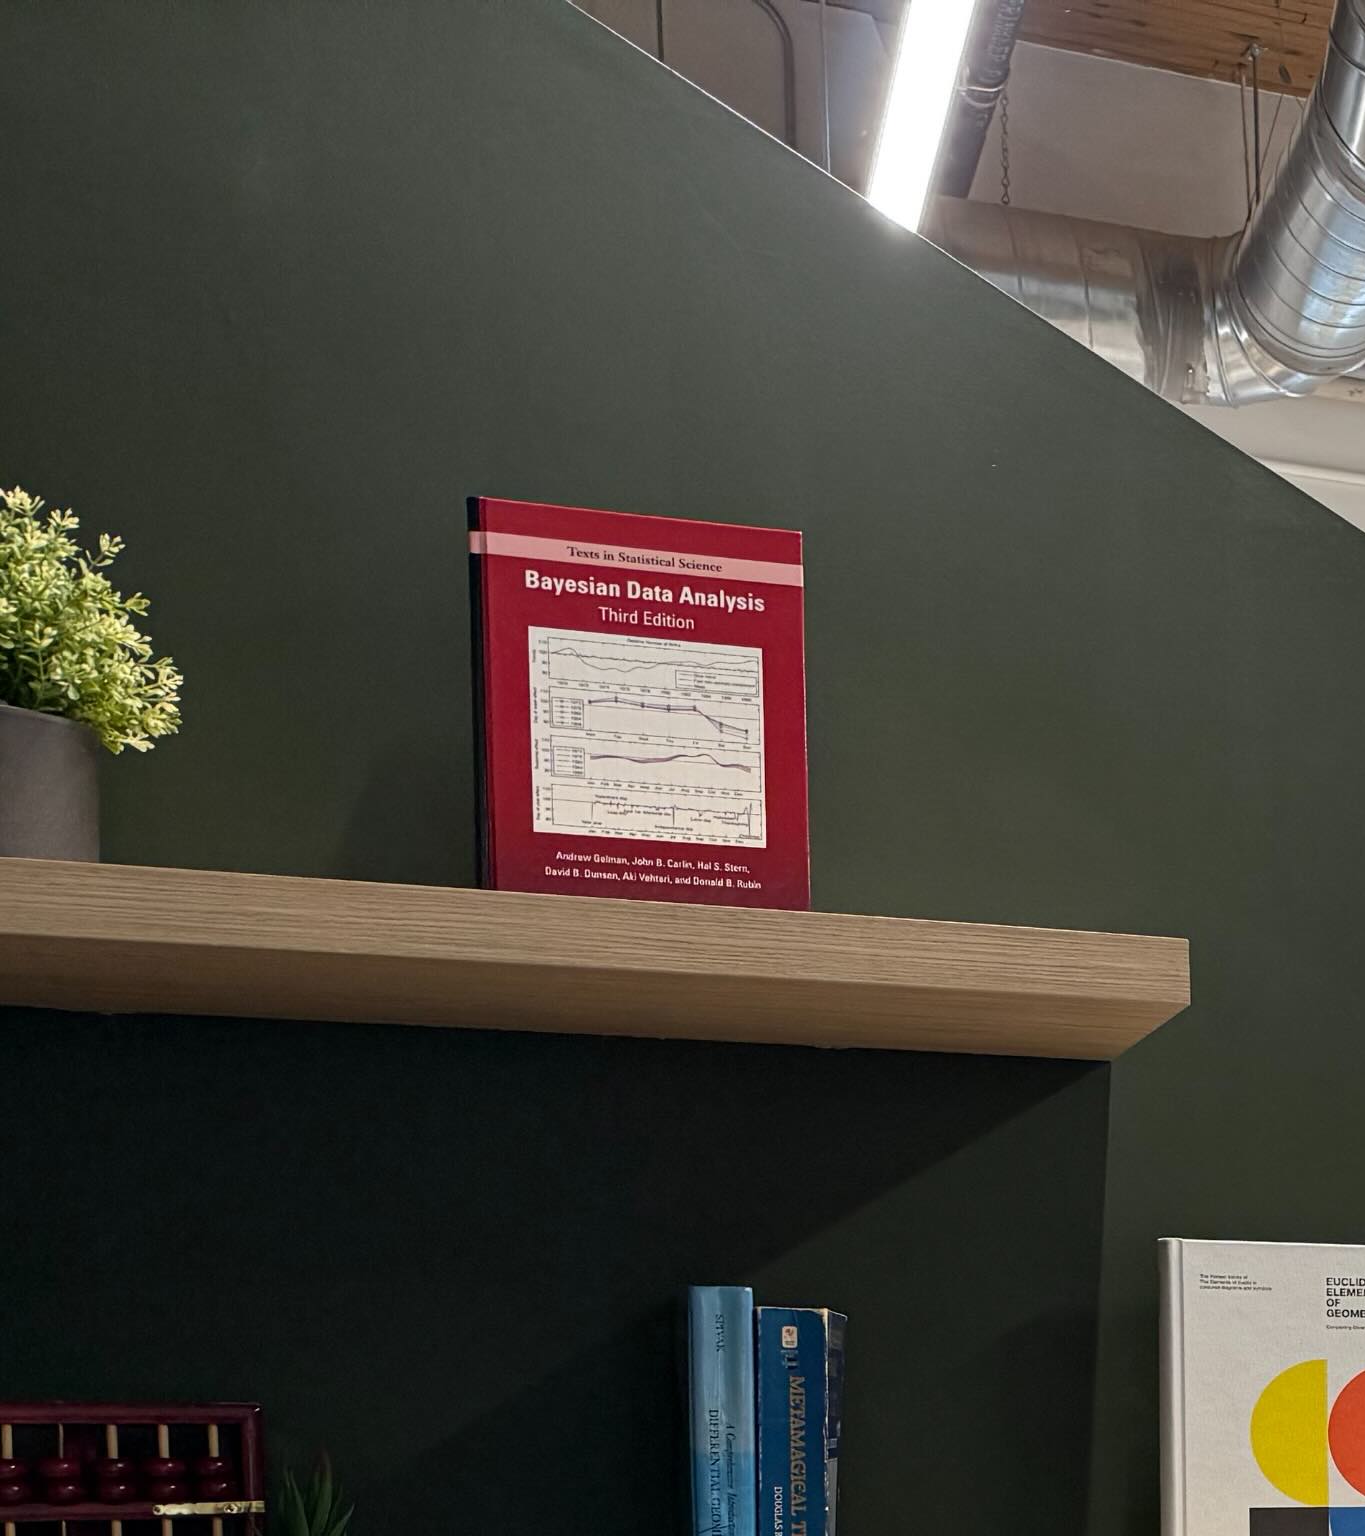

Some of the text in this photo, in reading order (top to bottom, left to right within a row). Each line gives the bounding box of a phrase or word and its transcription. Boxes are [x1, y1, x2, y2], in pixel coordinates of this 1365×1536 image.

[567, 546, 722, 572] Texts in Statistical Science
[525, 570, 766, 612] Bayesian Data Analysis
[598, 606, 695, 630] Third Edition
[545, 867, 762, 889] David B. Dunson, Aki Vehtari, and Donald B. Rubin
[556, 851, 751, 874] Andrew Gelman, John B. Carlin, Hal S. Stern,
[1326, 1298, 1341, 1307] OF
[715, 1314, 725, 1352] SPIVAK
[709, 1409, 721, 1495] DIFFERENTIAL
[789, 1376, 807, 1516] METAMAGICAL
[774, 1486, 782, 1529] DOUGLAS
